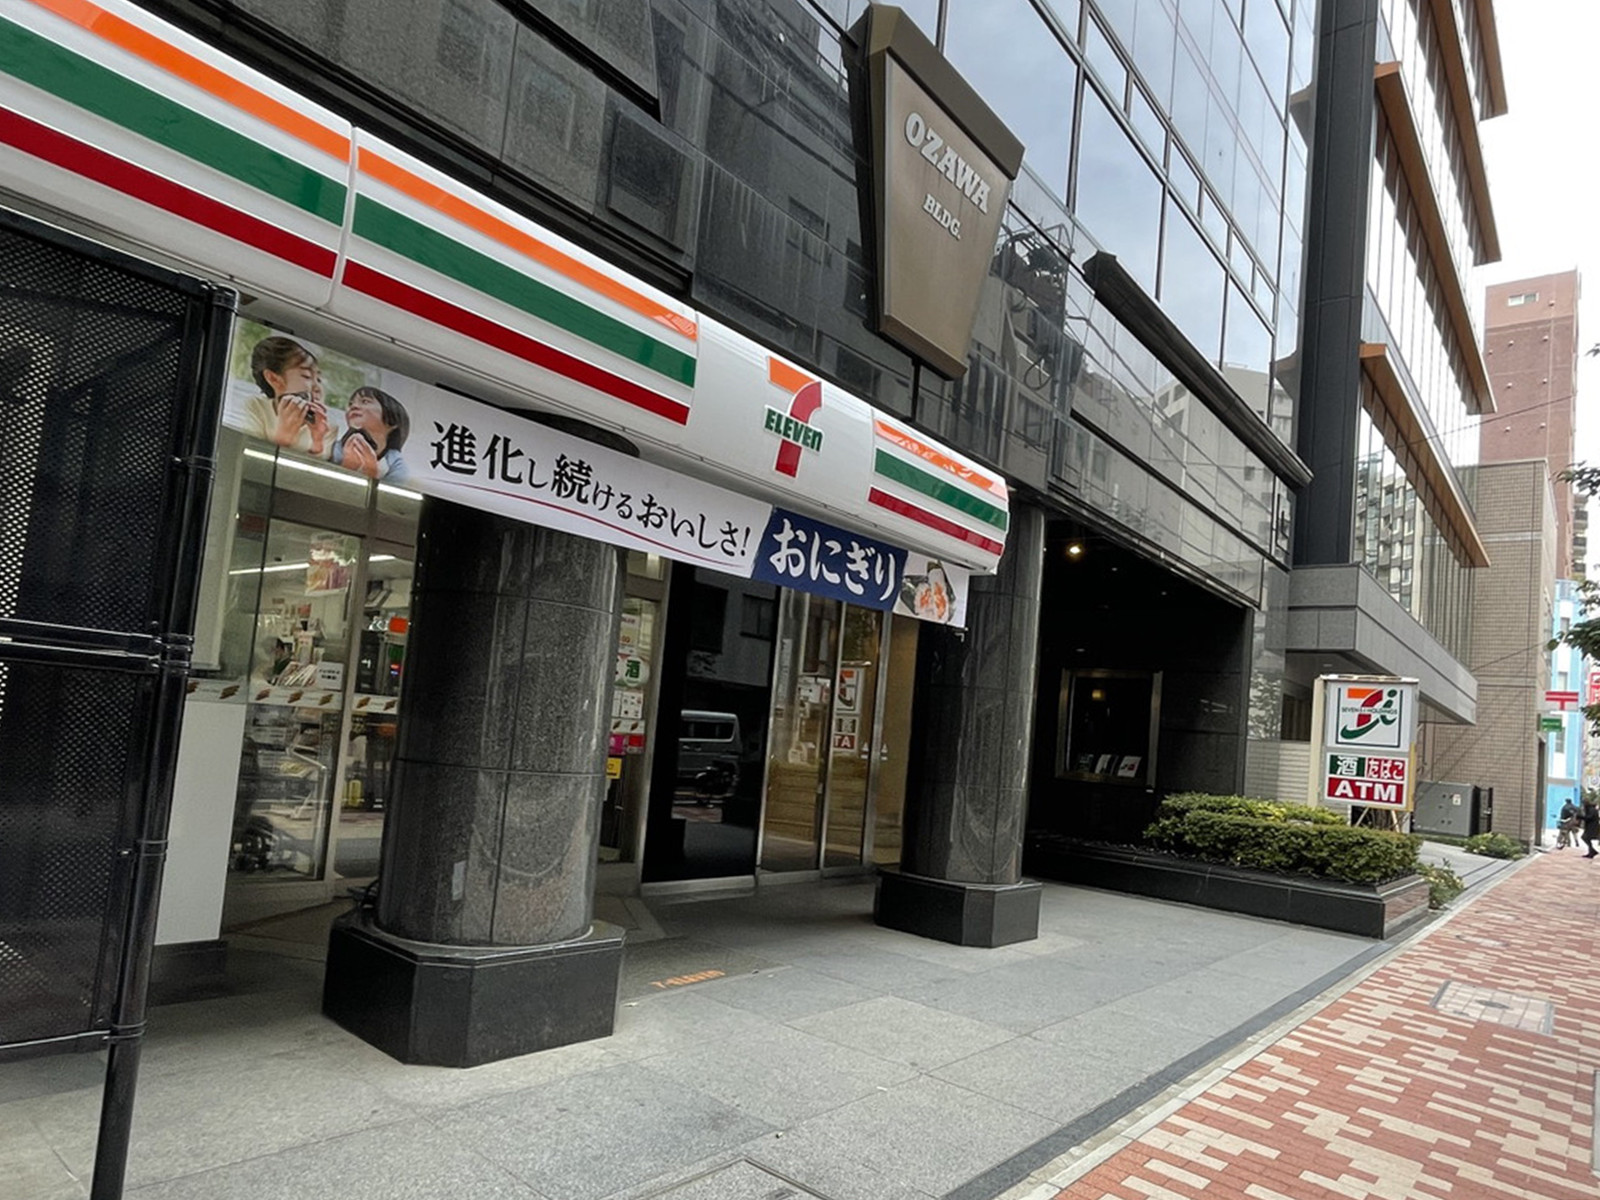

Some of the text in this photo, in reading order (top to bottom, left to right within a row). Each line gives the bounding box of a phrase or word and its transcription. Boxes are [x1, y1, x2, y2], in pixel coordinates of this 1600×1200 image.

[905, 112, 991, 214] OZAWA
[922, 193, 961, 240] BLDG.
[430, 421, 751, 557] 進化し続けるおいしさ!
[769, 518, 896, 601] おにぎり
[1334, 780, 1397, 802] ATM
[1336, 755, 1405, 780] 酒 たばこ
